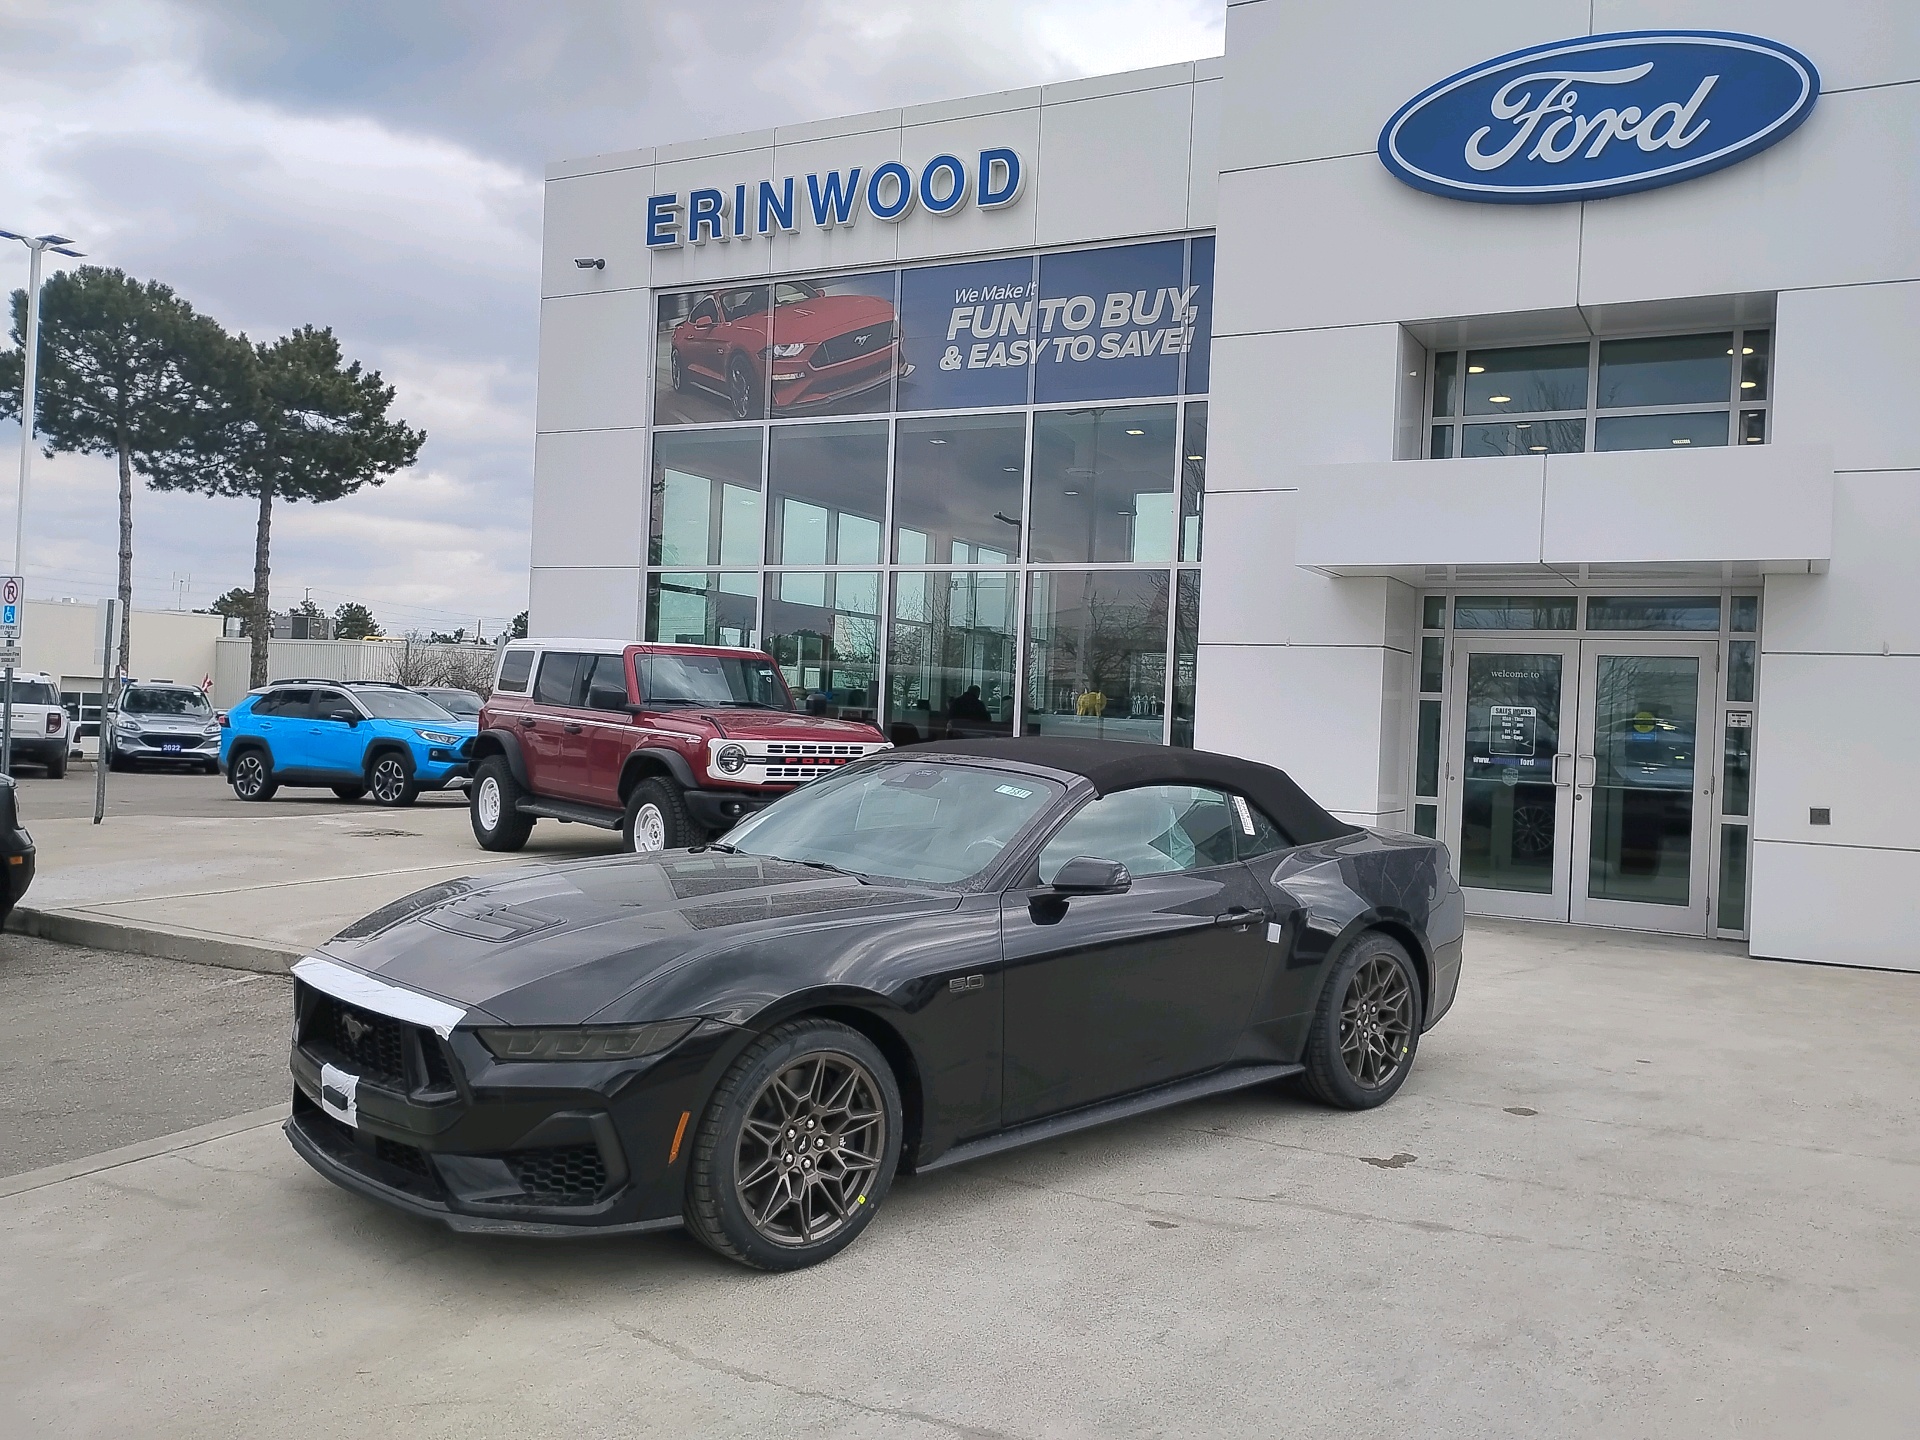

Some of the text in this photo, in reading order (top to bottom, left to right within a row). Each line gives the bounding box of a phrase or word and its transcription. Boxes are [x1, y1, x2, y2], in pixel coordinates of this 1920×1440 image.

[1464, 61, 1720, 171] Ford
[645, 147, 1023, 249] ERINWOOD
[954, 281, 1037, 304] We Make It
[946, 284, 1200, 341] FUN TO BUY,
[939, 326, 1195, 371] & EASY TO SAVE!
[1491, 669, 1540, 679] welcome to
[1495, 707, 1512, 716] SALES
[785, 757, 846, 765] FORD
[949, 974, 985, 992] 5.0
